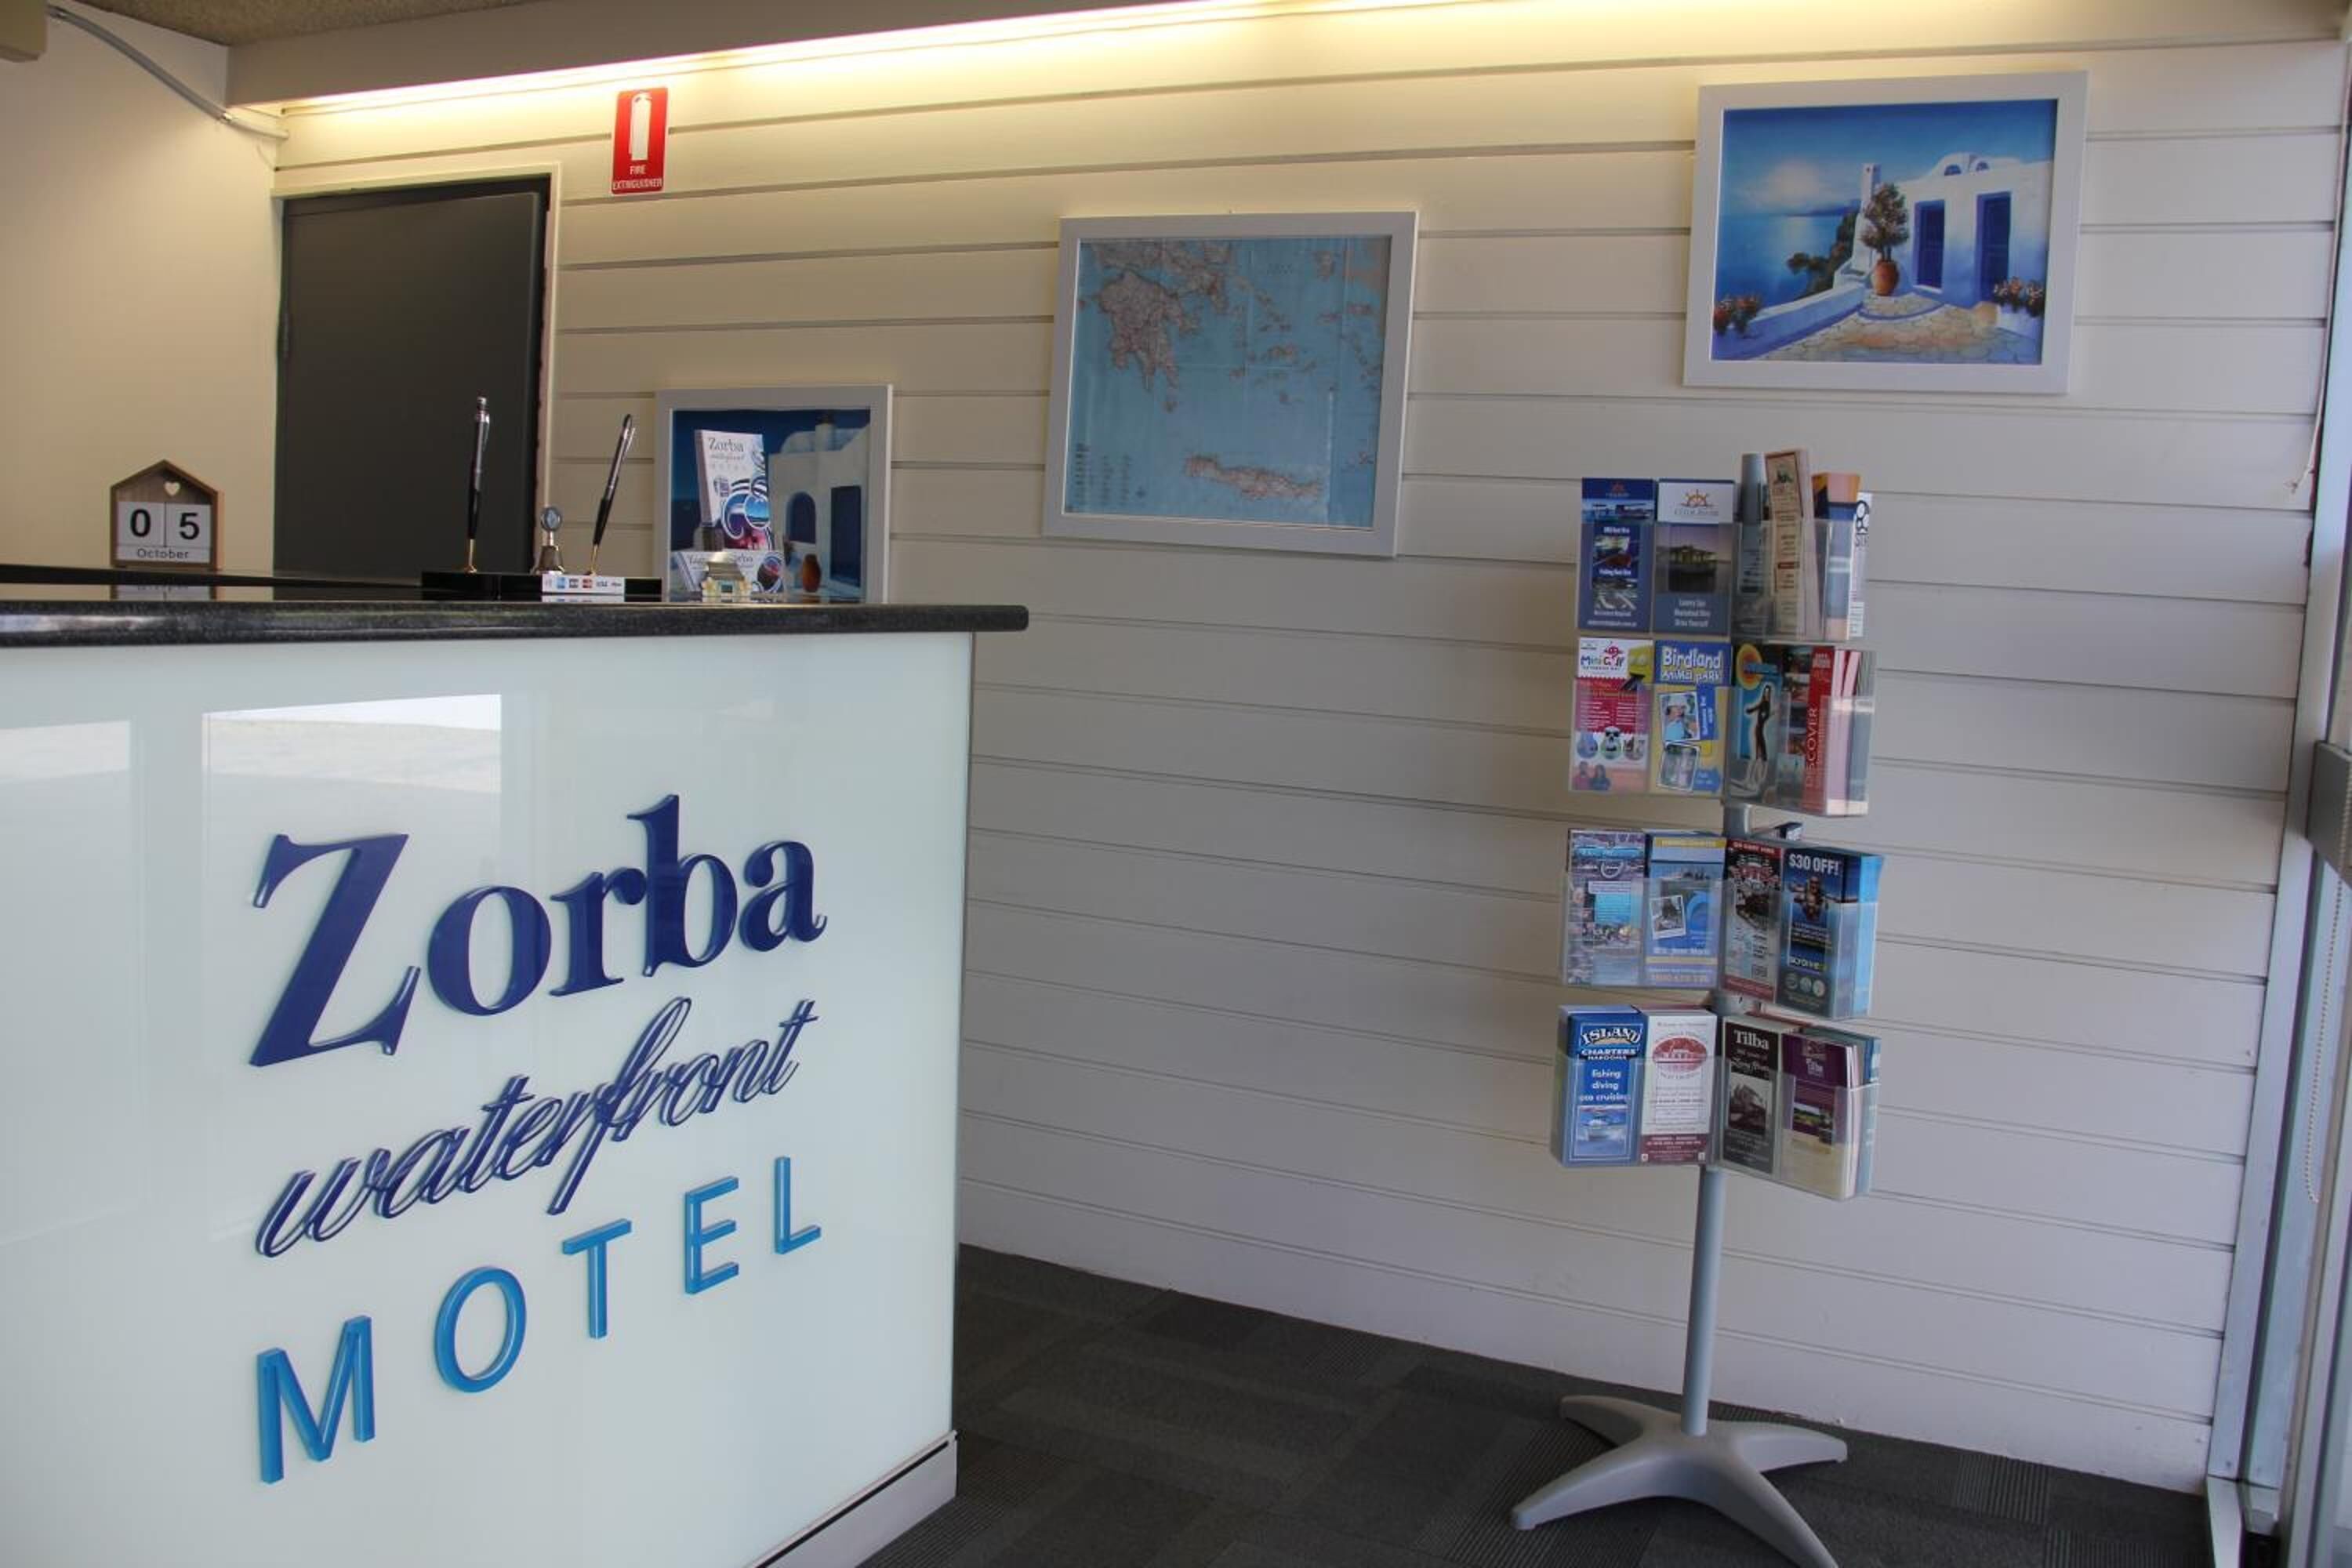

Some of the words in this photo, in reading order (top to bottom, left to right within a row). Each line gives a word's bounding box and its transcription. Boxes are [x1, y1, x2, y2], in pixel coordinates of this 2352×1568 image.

[630, 165, 647, 175] FIRE
[612, 178, 662, 190] EXTINGUISHER
[708, 437, 744, 452] Zorba
[137, 547, 189, 560] October
[1662, 646, 1723, 669] Birdland
[1806, 707, 1819, 788] DISCOVER
[1789, 853, 1810, 871] $30
[1813, 857, 1840, 876] OFF!
[249, 793, 827, 1067] Zorba
[1582, 1028, 1641, 1044] ISLAND
[1733, 1029, 1769, 1049] Tilba
[1592, 1069, 1621, 1080] fishing
[1592, 1080, 1619, 1091] diving
[255, 996, 818, 1258] waterfront
[256, 1156, 822, 1484] MOTEL
